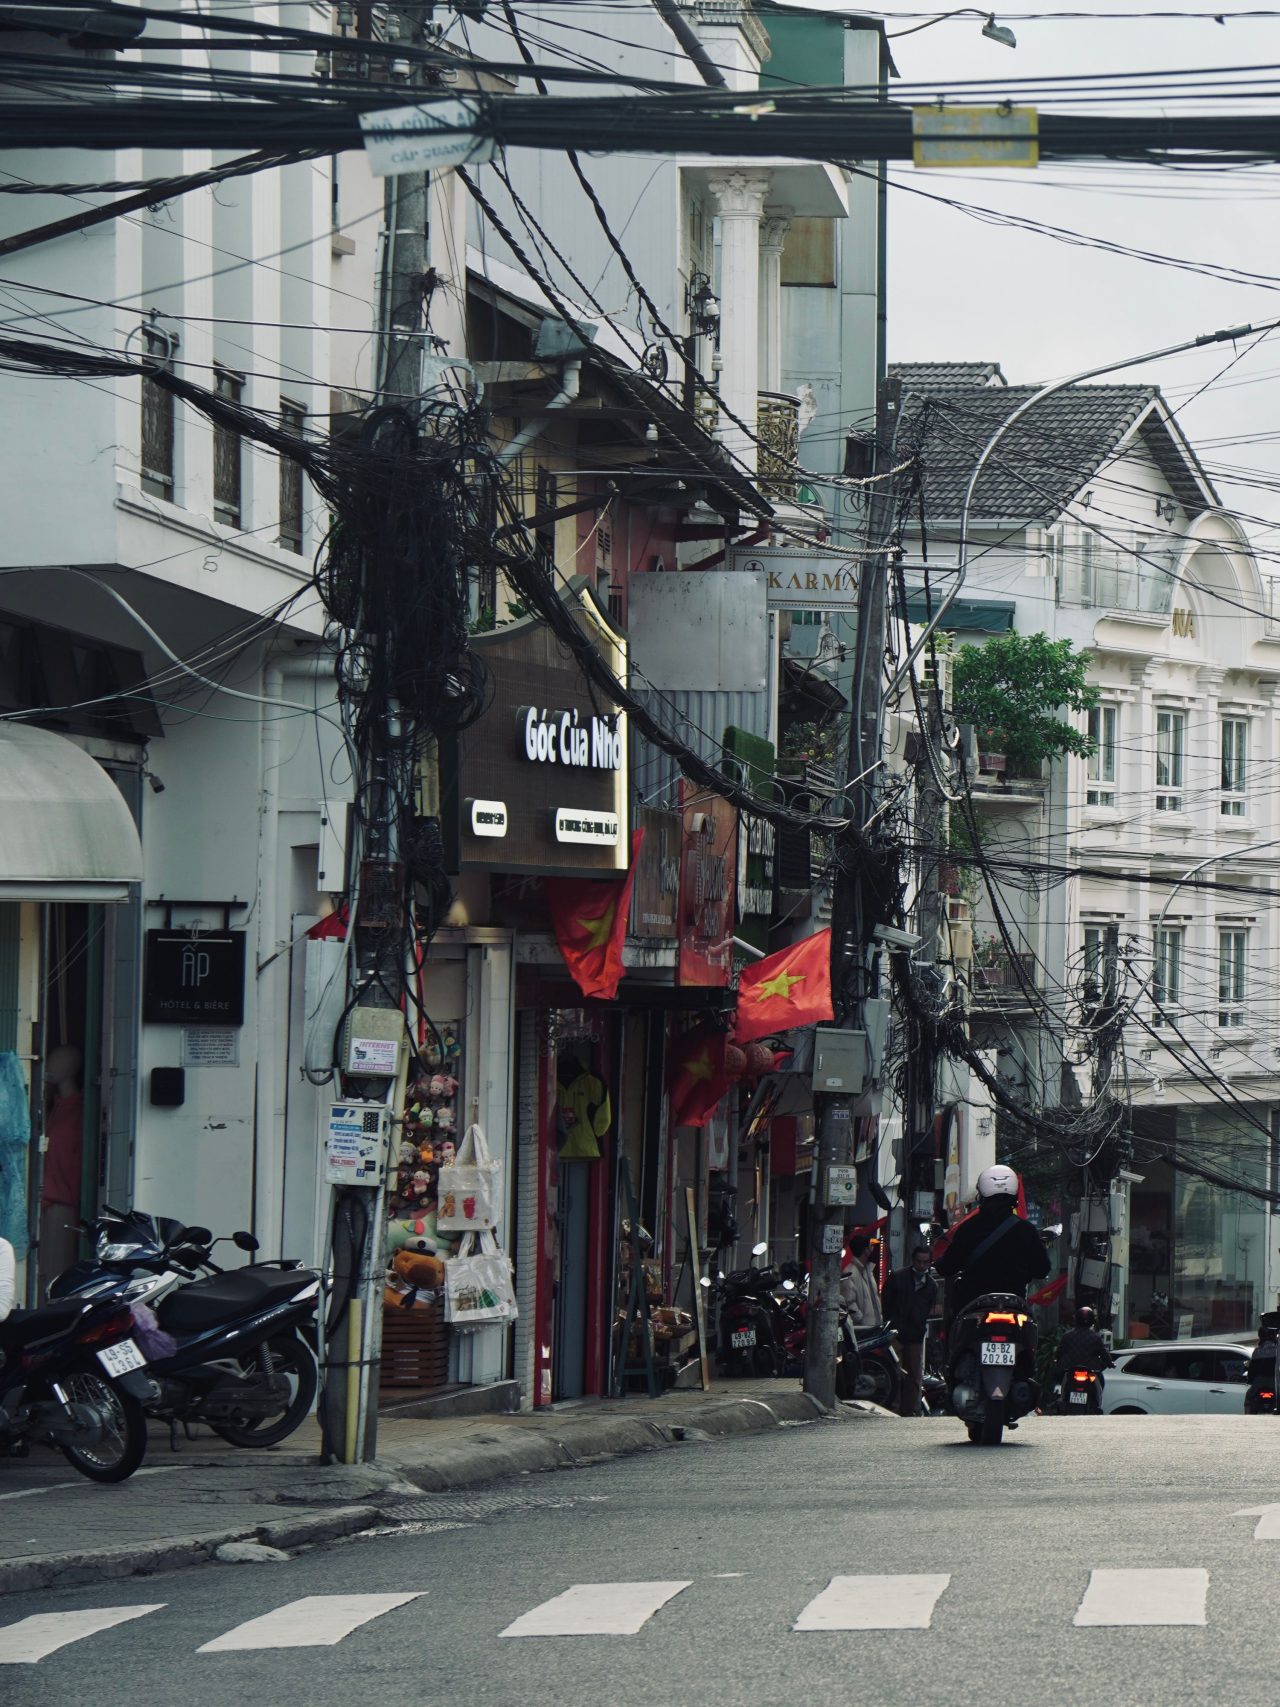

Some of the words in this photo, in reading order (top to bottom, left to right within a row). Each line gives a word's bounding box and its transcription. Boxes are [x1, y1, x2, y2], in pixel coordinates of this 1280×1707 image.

[768, 571, 858, 590] KARMA
[526, 706, 556, 763] Góc
[560, 708, 588, 767] Của
[592, 714, 622, 770] Nhỏ
[986, 1344, 1011, 1354] 49-B2
[983, 1354, 1014, 1364] 202.84
